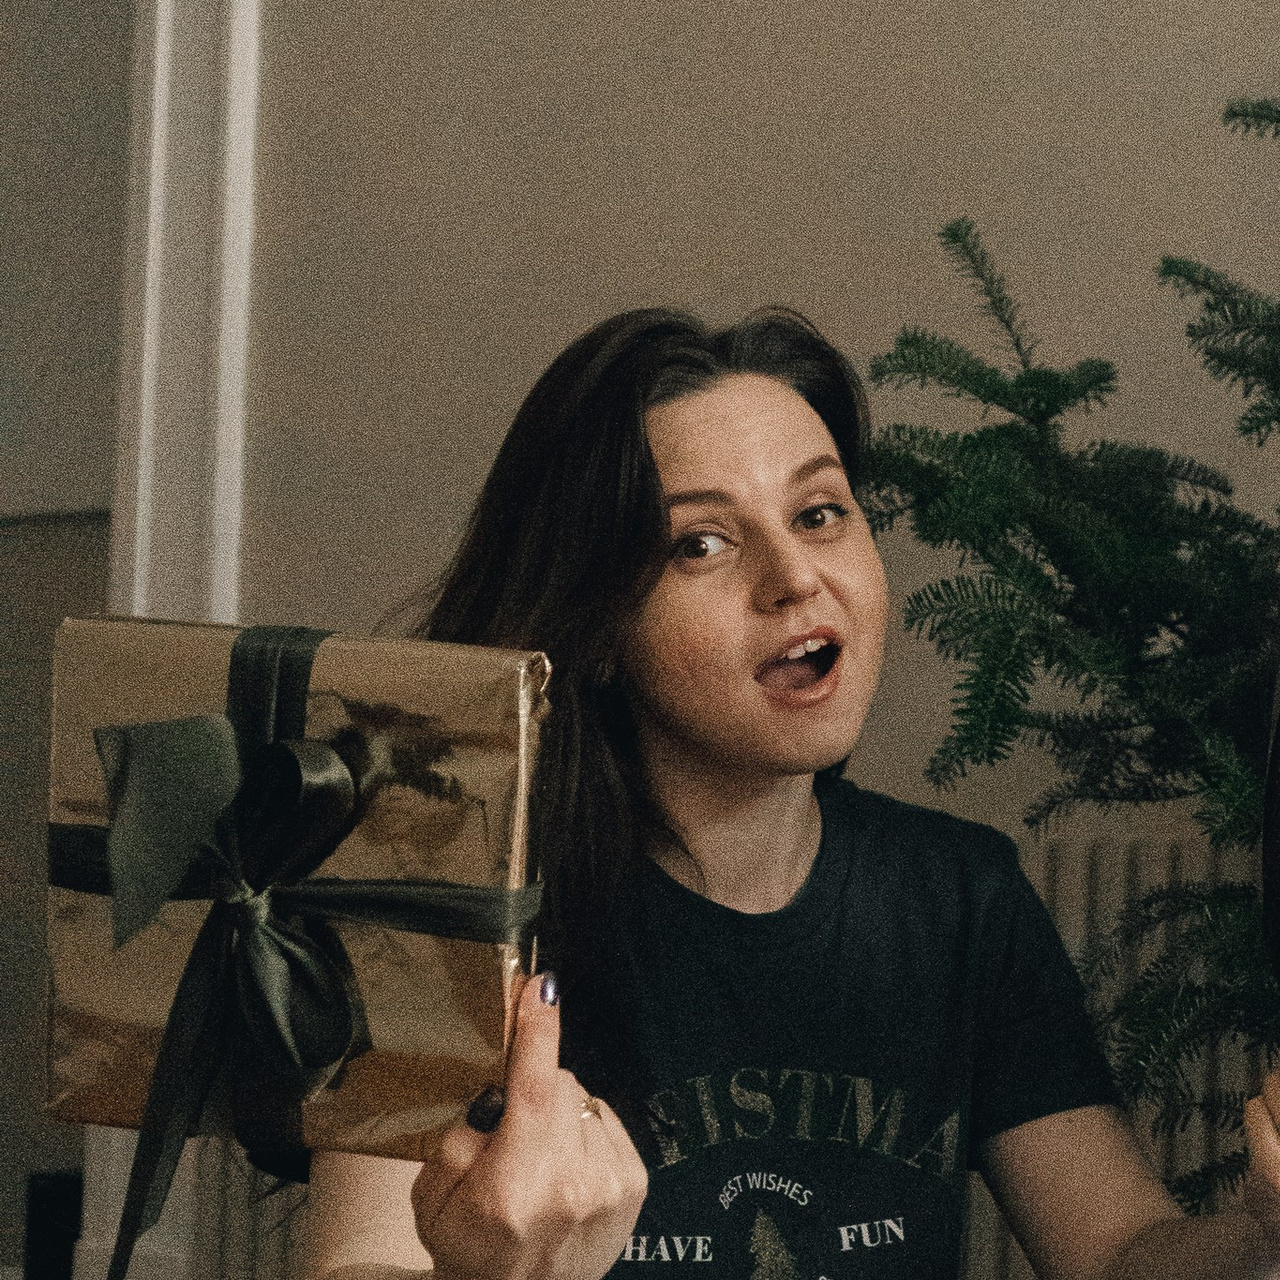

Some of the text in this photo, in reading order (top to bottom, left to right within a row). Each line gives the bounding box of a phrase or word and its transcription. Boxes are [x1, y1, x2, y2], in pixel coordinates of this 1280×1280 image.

[718, 1171, 815, 1211] BEST WISHES
[621, 1216, 905, 1264] HAVE FUN
